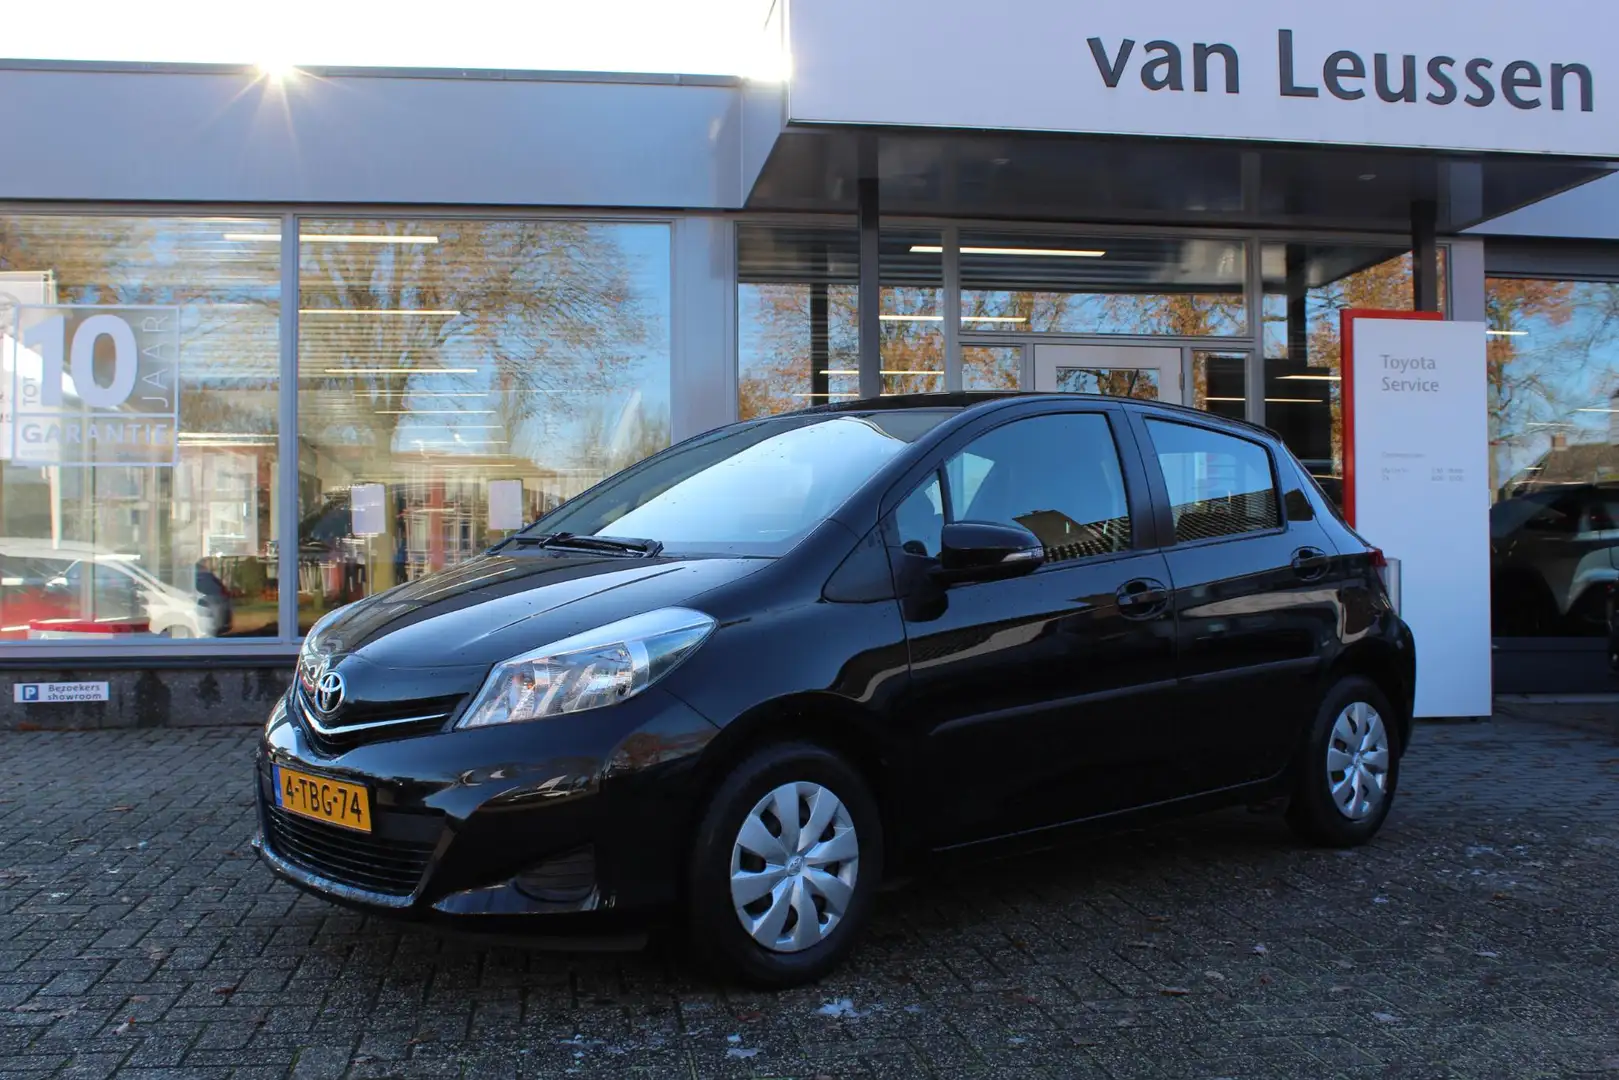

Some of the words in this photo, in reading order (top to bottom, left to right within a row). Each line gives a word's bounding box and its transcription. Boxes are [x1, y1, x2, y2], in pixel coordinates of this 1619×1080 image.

[1087, 37, 1240, 94] van
[1278, 29, 1594, 112] Leussen
[23, 314, 139, 408] 10
[141, 316, 169, 408] JAAR
[1381, 354, 1437, 374] Toyota
[22, 376, 37, 406] TOT
[1381, 376, 1440, 392] Service
[21, 422, 169, 446] GARANTIE
[47, 692, 102, 701] showroom
[48, 684, 100, 693] Bezoekers
[286, 775, 362, 823] 4-TBG-74
